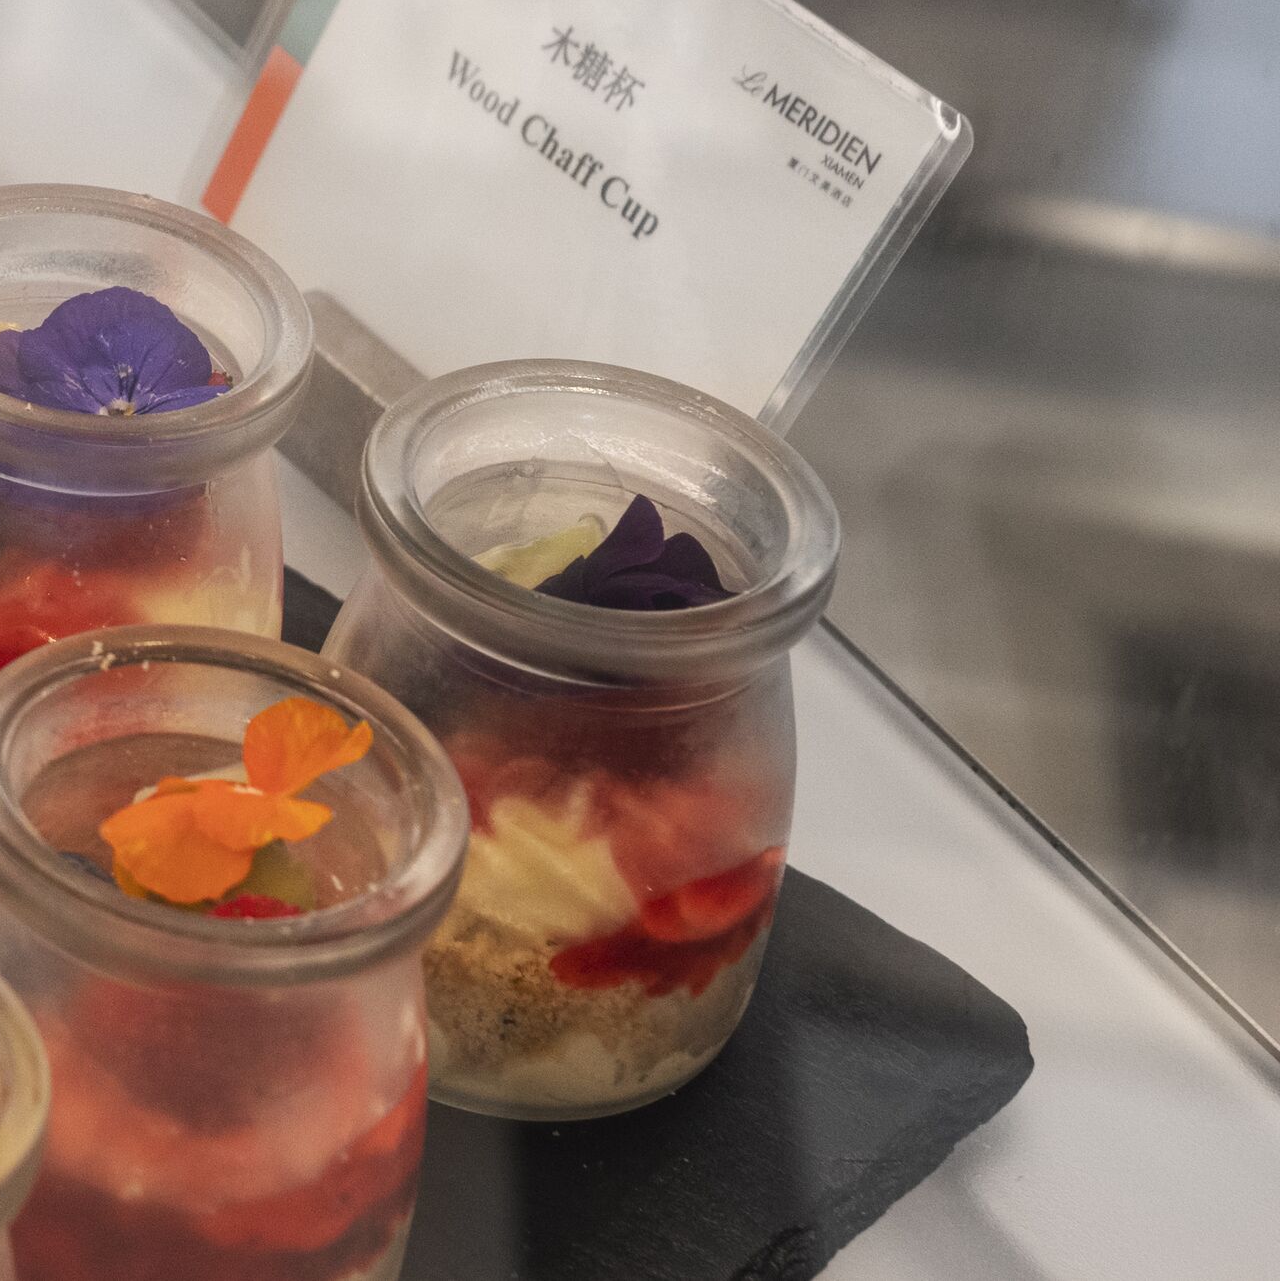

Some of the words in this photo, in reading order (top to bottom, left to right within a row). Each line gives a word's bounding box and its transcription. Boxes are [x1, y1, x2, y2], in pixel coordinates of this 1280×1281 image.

[542, 26, 646, 112] 木糖杯
[449, 49, 520, 126] Wood
[521, 114, 604, 188] Chaff
[600, 175, 659, 240] Cup
[733, 65, 768, 97] Le
[763, 83, 882, 175] MERIDIEN
[821, 154, 865, 190] XIAMEN
